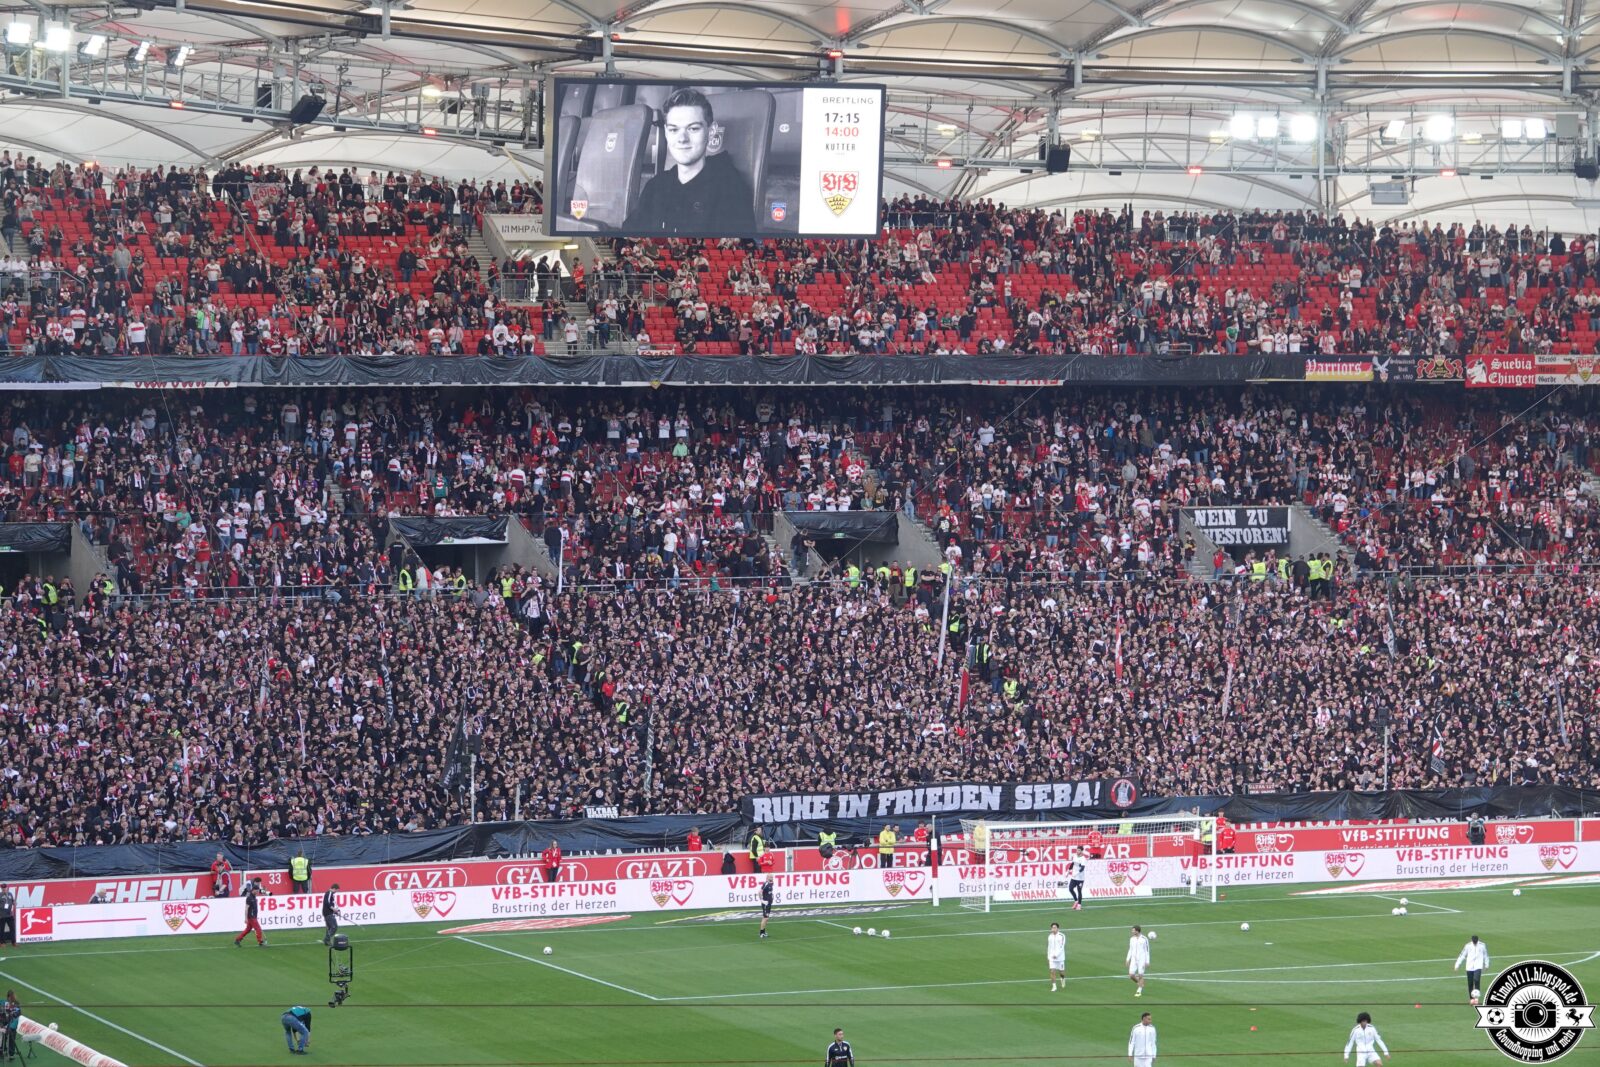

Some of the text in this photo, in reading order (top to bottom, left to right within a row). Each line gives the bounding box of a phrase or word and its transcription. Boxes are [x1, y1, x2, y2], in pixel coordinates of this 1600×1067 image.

[822, 96, 874, 104] BREITLING
[824, 112, 860, 123] 17:15
[824, 126, 859, 137] 14:00
[825, 143, 856, 151] KUTTER
[822, 173, 857, 192] VfB
[1491, 358, 1532, 370] Suebia
[1194, 509, 1269, 526] NEIN ZU
[753, 794, 829, 822] RUHE
[837, 794, 870, 819] IN
[876, 785, 1002, 816] FRIEDEN
[1014, 782, 1100, 810] SEBA!
[1172, 836, 1184, 846] 35
[1342, 827, 1449, 842] VfB-STIFTUNG
[1396, 846, 1508, 862] VfB-STIFTUNG
[1181, 854, 1294, 870] VB-STIFTUNG
[1234, 871, 1251, 881] der
[1256, 870, 1294, 880] Herzen
[1396, 862, 1508, 876] Brustring der Herzen
[268, 873, 282, 884] 33
[728, 872, 850, 889] VfB-TIFTUNG
[491, 882, 617, 900] VfB-STIFTUNG
[959, 881, 1009, 893] Brustring
[1015, 880, 1032, 890] der
[1090, 887, 1136, 896] WINAMAX
[786, 890, 804, 900] der
[809, 889, 850, 900] Herzen
[1011, 889, 1058, 900] WINAMAX
[258, 893, 376, 911] fB-STIFUNG
[492, 899, 617, 914] Brustring der Herzen
[257, 915, 303, 926] ustring
[308, 912, 322, 923] de
